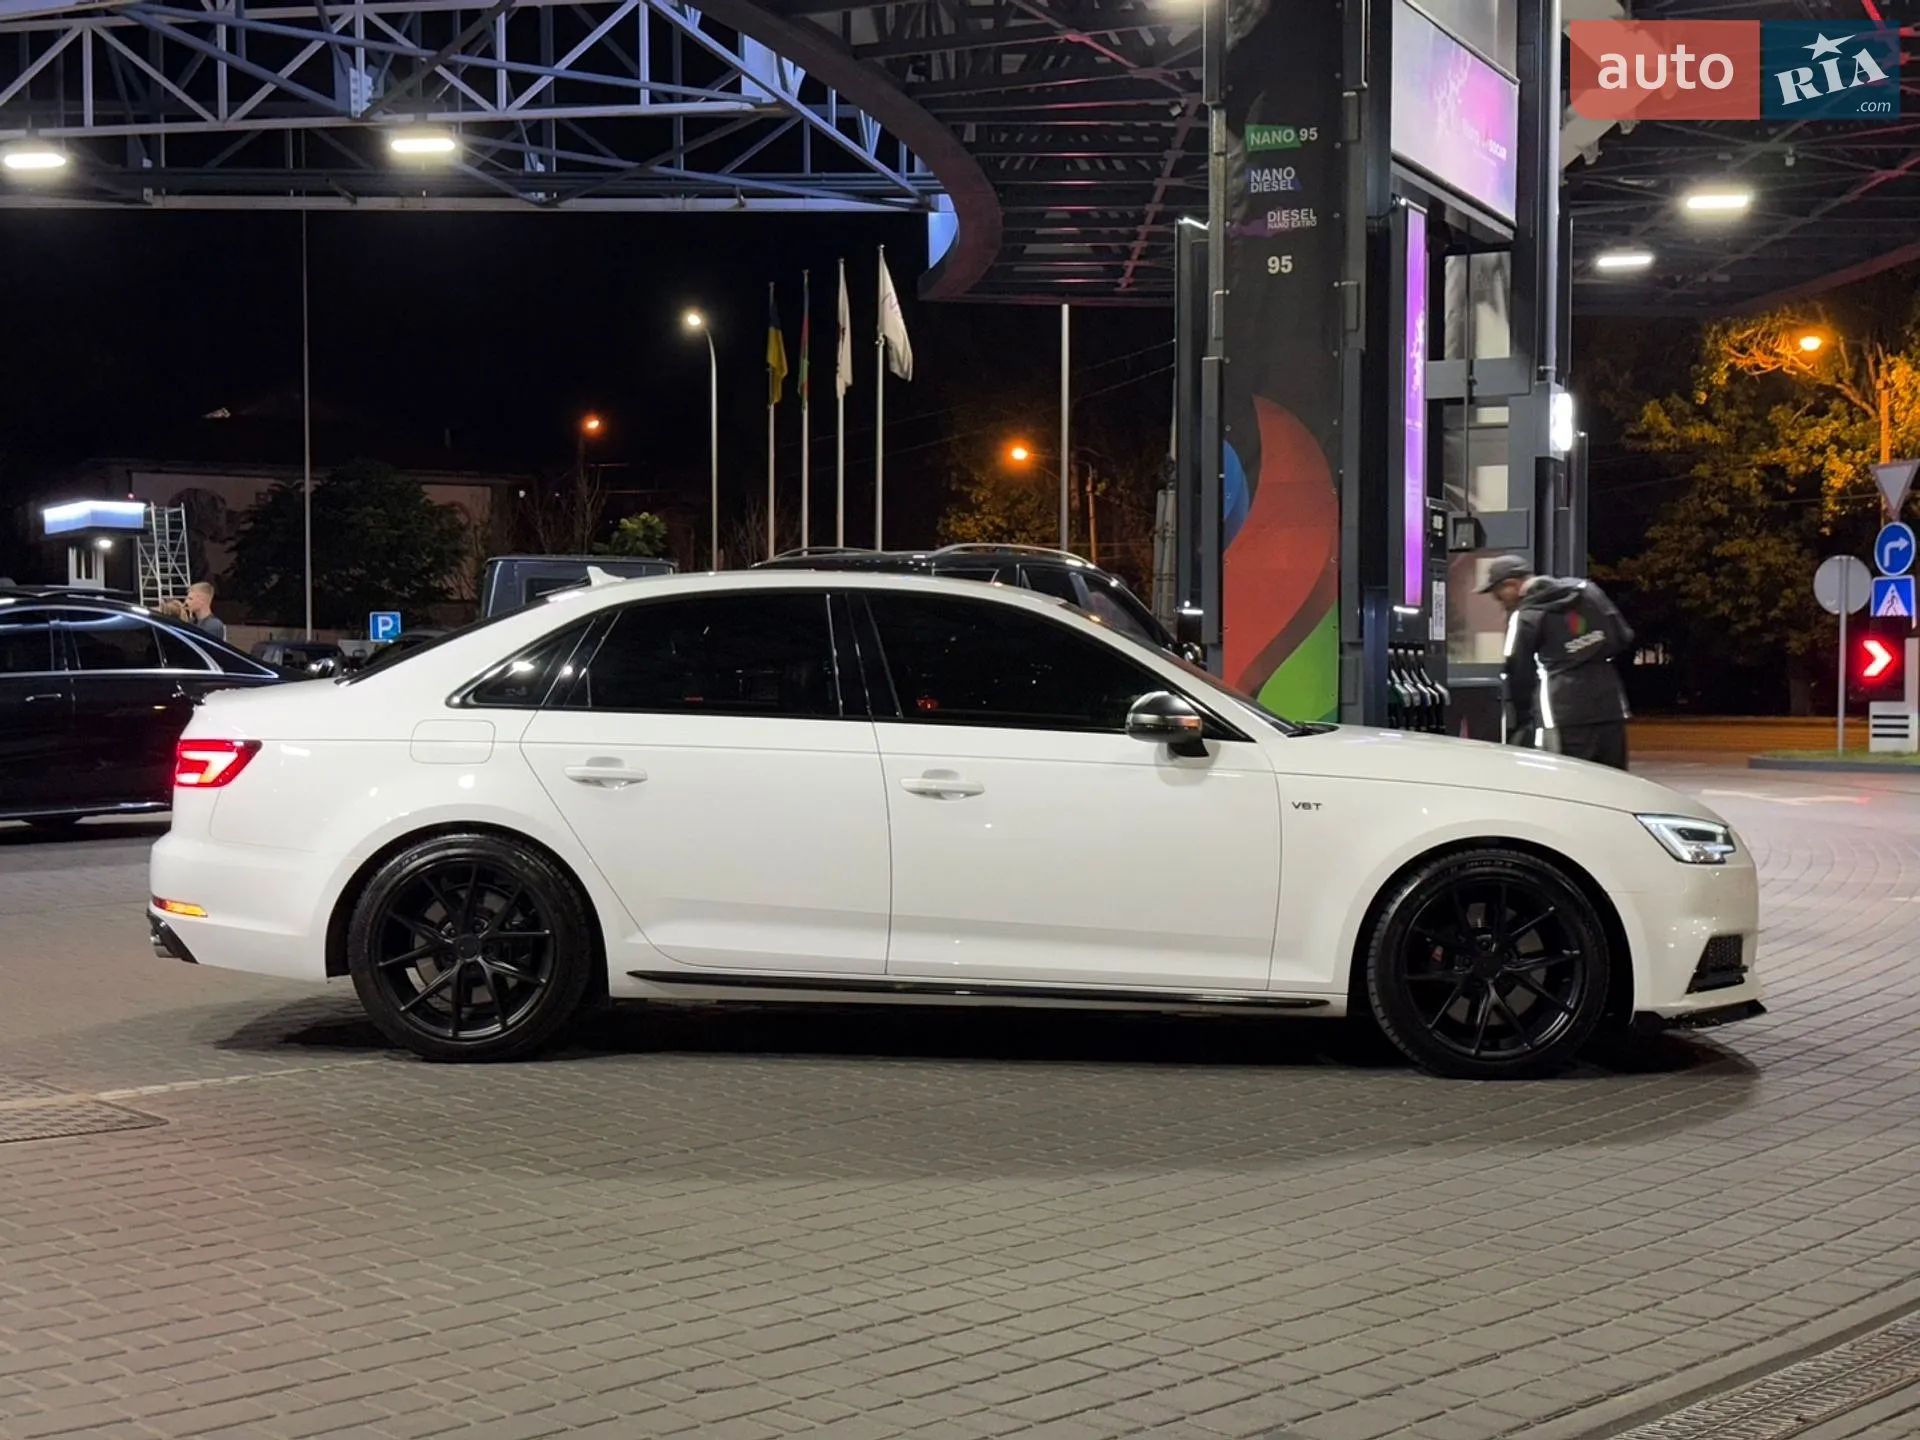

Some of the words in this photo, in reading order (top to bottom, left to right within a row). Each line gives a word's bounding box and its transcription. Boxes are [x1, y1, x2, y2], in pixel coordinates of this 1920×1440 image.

[1250, 129, 1295, 146] NANO
[1299, 127, 1318, 142] 95
[1251, 166, 1296, 183] NANO
[1250, 180, 1295, 193] DIESEL
[1267, 208, 1317, 223] DIESEL
[1267, 221, 1289, 230] NANO
[1267, 255, 1293, 274] 95
[377, 616, 393, 638] P
